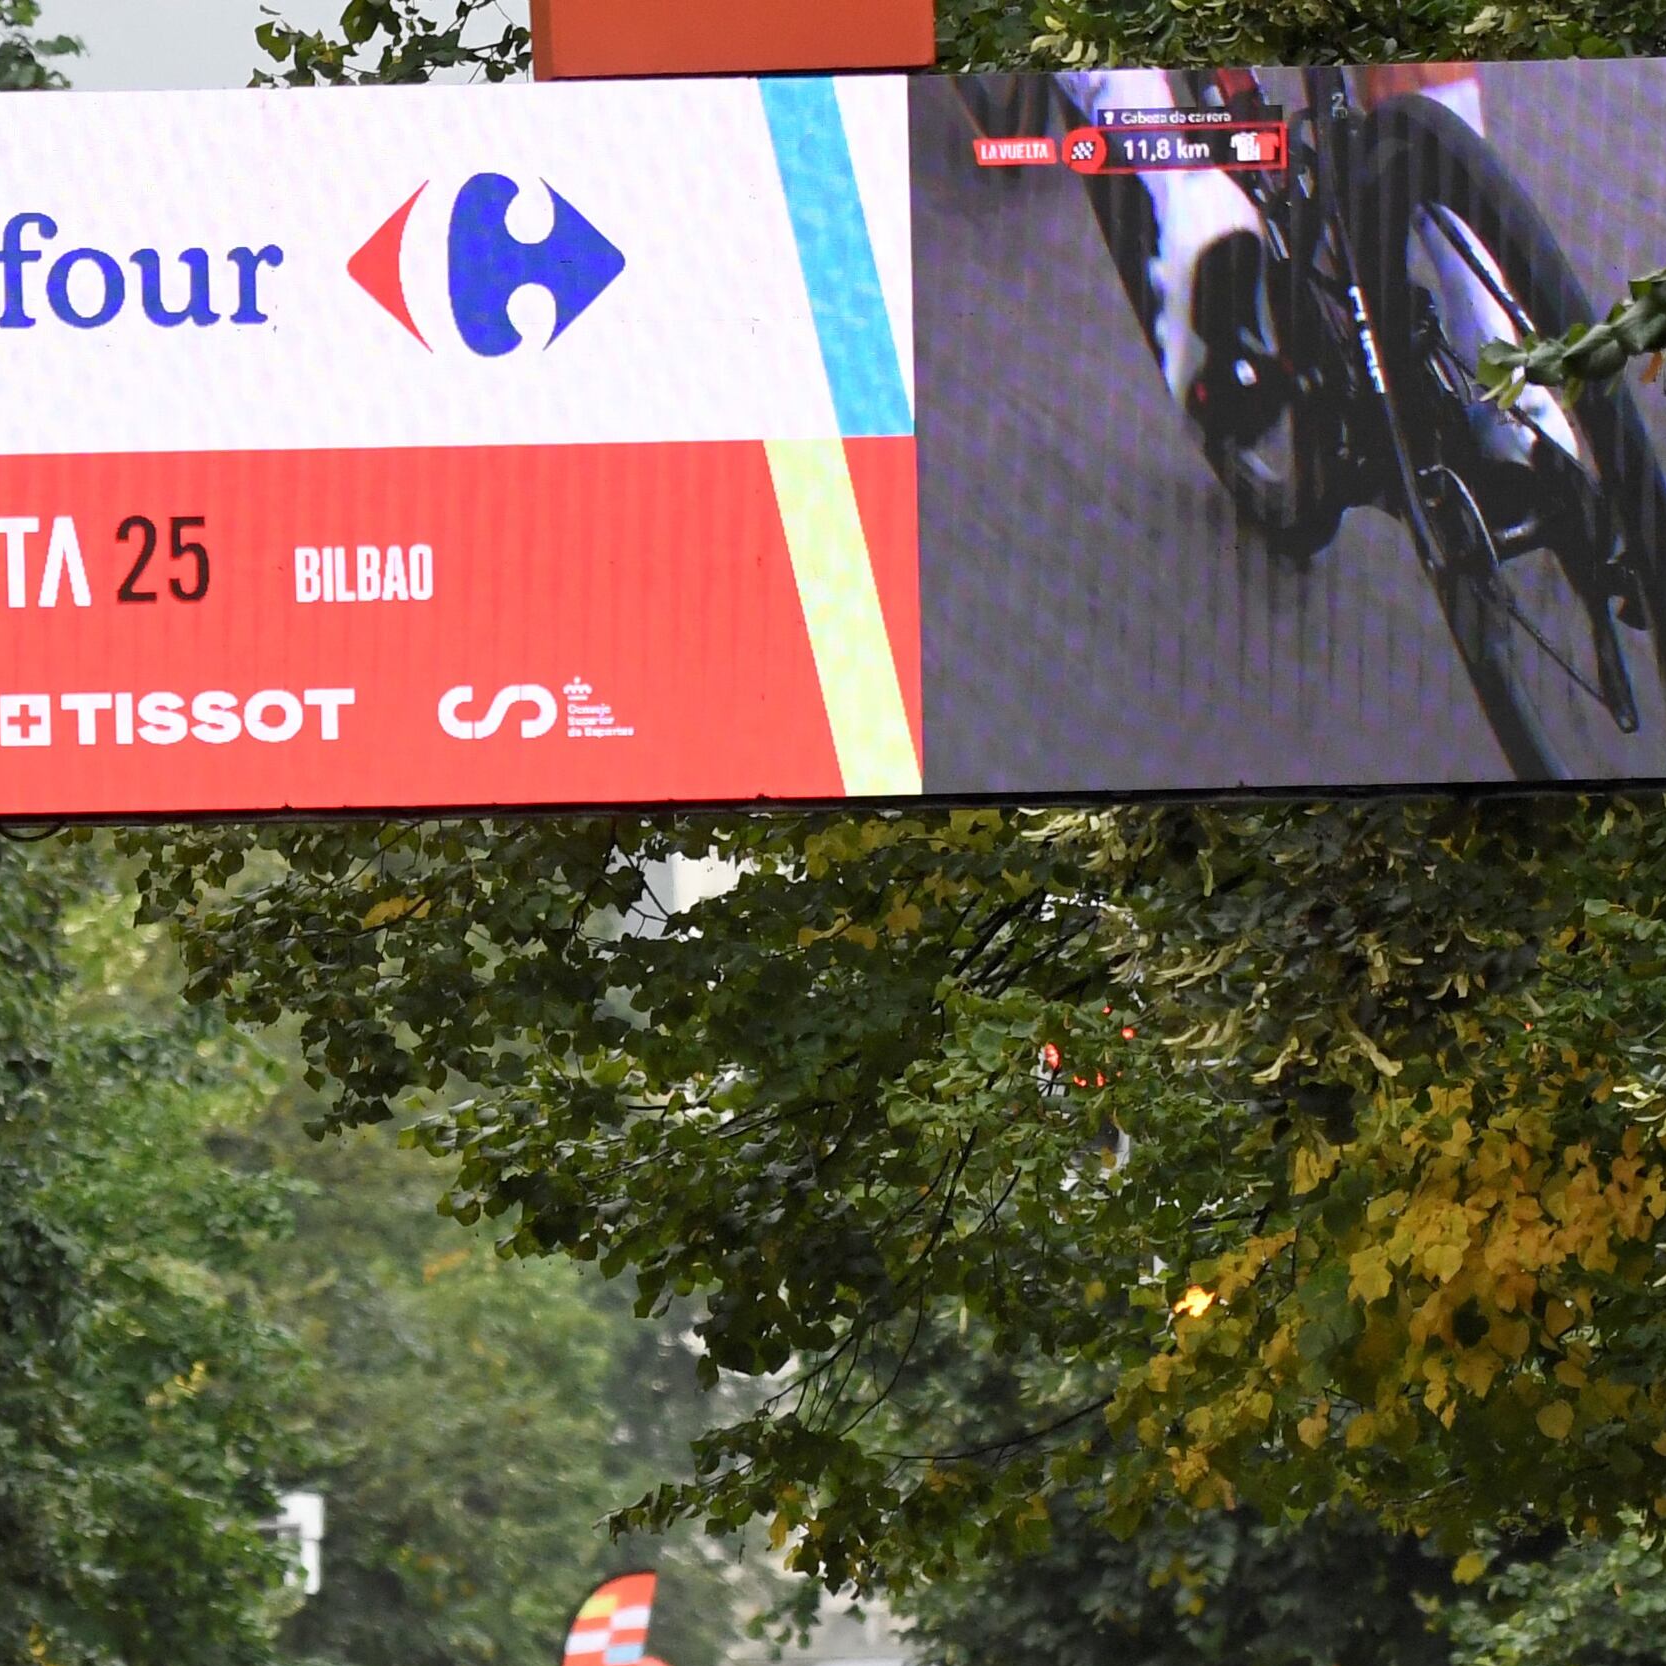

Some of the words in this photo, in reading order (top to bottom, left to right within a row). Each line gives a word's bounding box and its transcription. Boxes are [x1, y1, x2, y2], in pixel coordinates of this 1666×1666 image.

[981, 144, 998, 160] LA
[998, 143, 1049, 160] VUELTA
[1123, 140, 1171, 162] 11,8
[1176, 138, 1210, 158] km
[115, 515, 211, 606] 25
[295, 543, 434, 604] BILBAO
[59, 687, 354, 745] TISSOT
